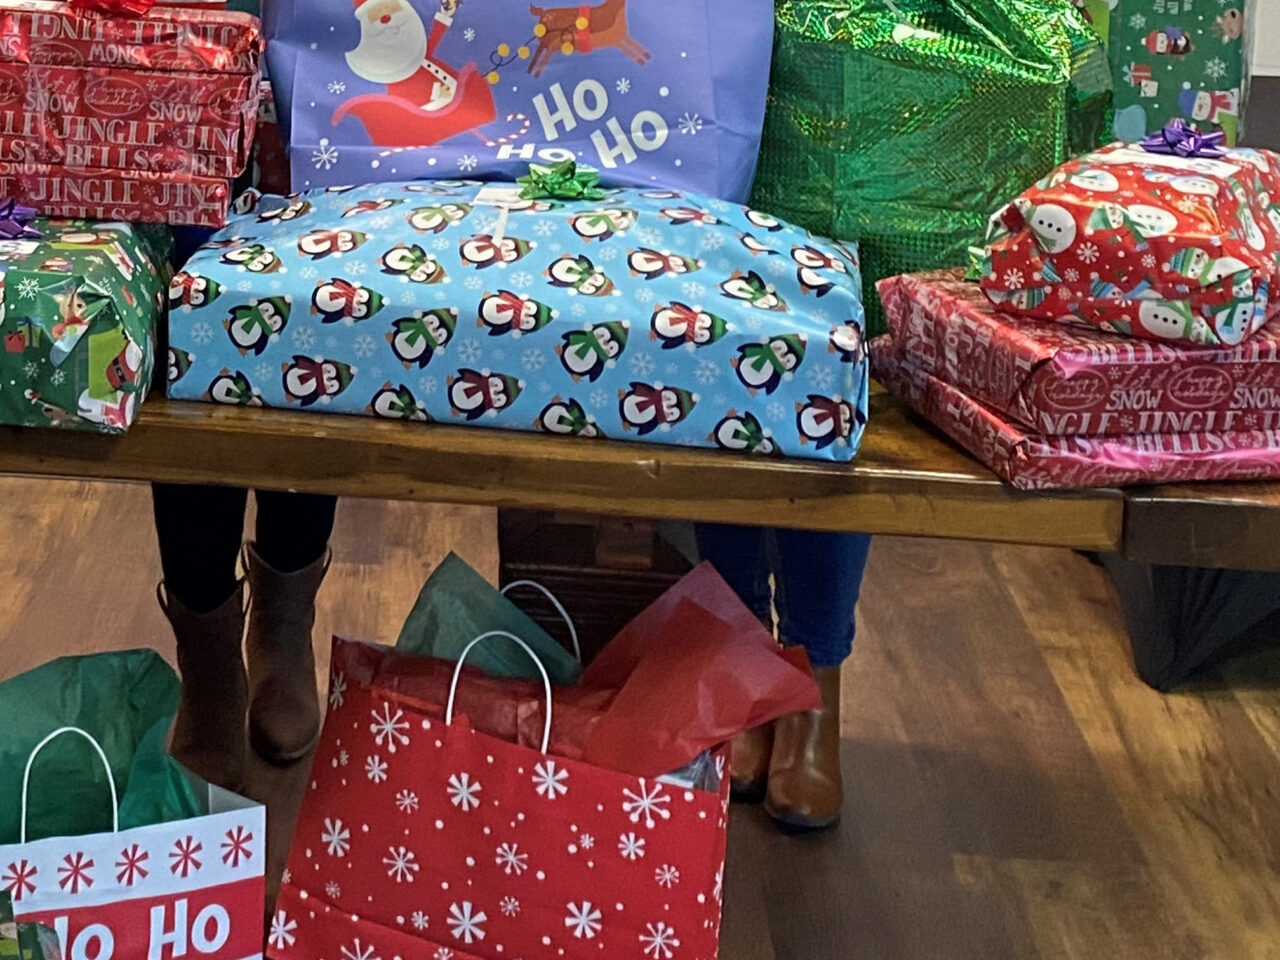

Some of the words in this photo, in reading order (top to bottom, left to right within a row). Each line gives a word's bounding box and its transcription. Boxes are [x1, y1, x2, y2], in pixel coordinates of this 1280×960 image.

[1167, 1, 1179, 15] all
[23, 91, 79, 113] SNOW
[146, 101, 203, 123] SNOW
[532, 79, 609, 141] HO
[54, 115, 165, 147] JINGLE
[177, 123, 240, 152] JIN
[590, 110, 669, 169] HO
[64, 144, 149, 171] BELLS
[191, 153, 239, 178] BEL
[496, 142, 577, 162] HO
[29, 177, 139, 205] JINGLE
[152, 182, 216, 207] JIN
[1105, 389, 1163, 411] SNOW
[1040, 411, 1119, 436] NGLE
[1136, 410, 1243, 434] JINGLE
[1136, 431, 1224, 454] BELLS
